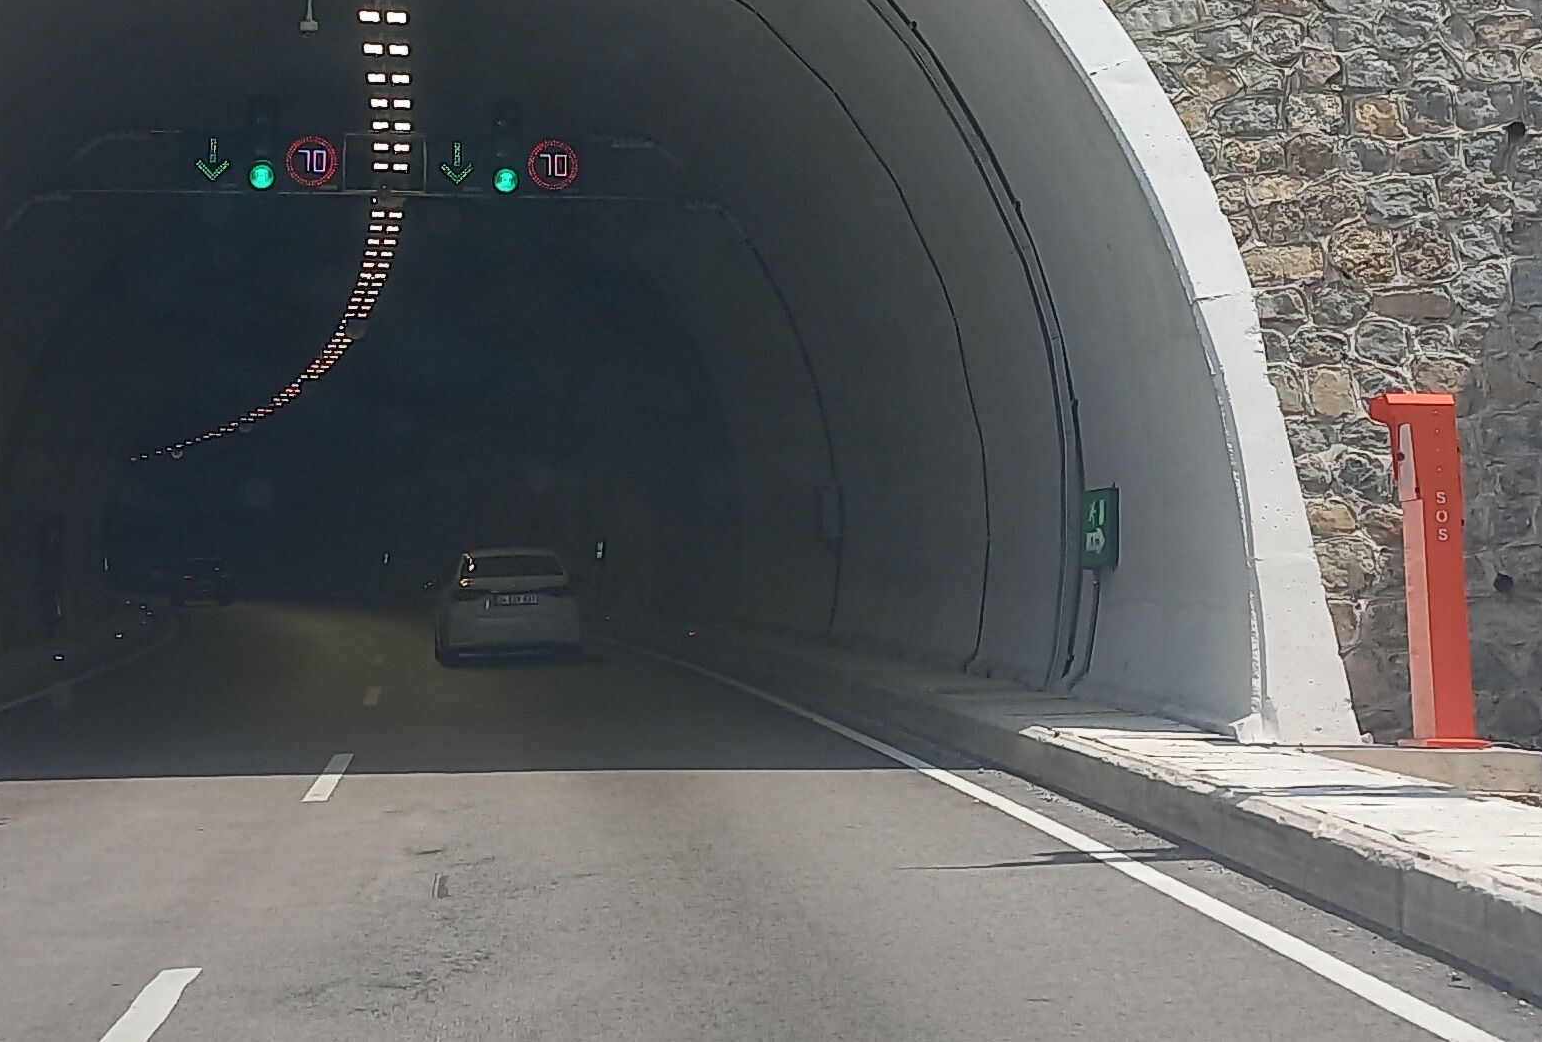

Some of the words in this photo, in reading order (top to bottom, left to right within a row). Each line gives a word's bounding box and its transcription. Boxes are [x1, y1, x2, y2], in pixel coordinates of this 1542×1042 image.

[298, 148, 327, 174] 70
[539, 153, 569, 179] 70
[1435, 491, 1448, 541] SOS
